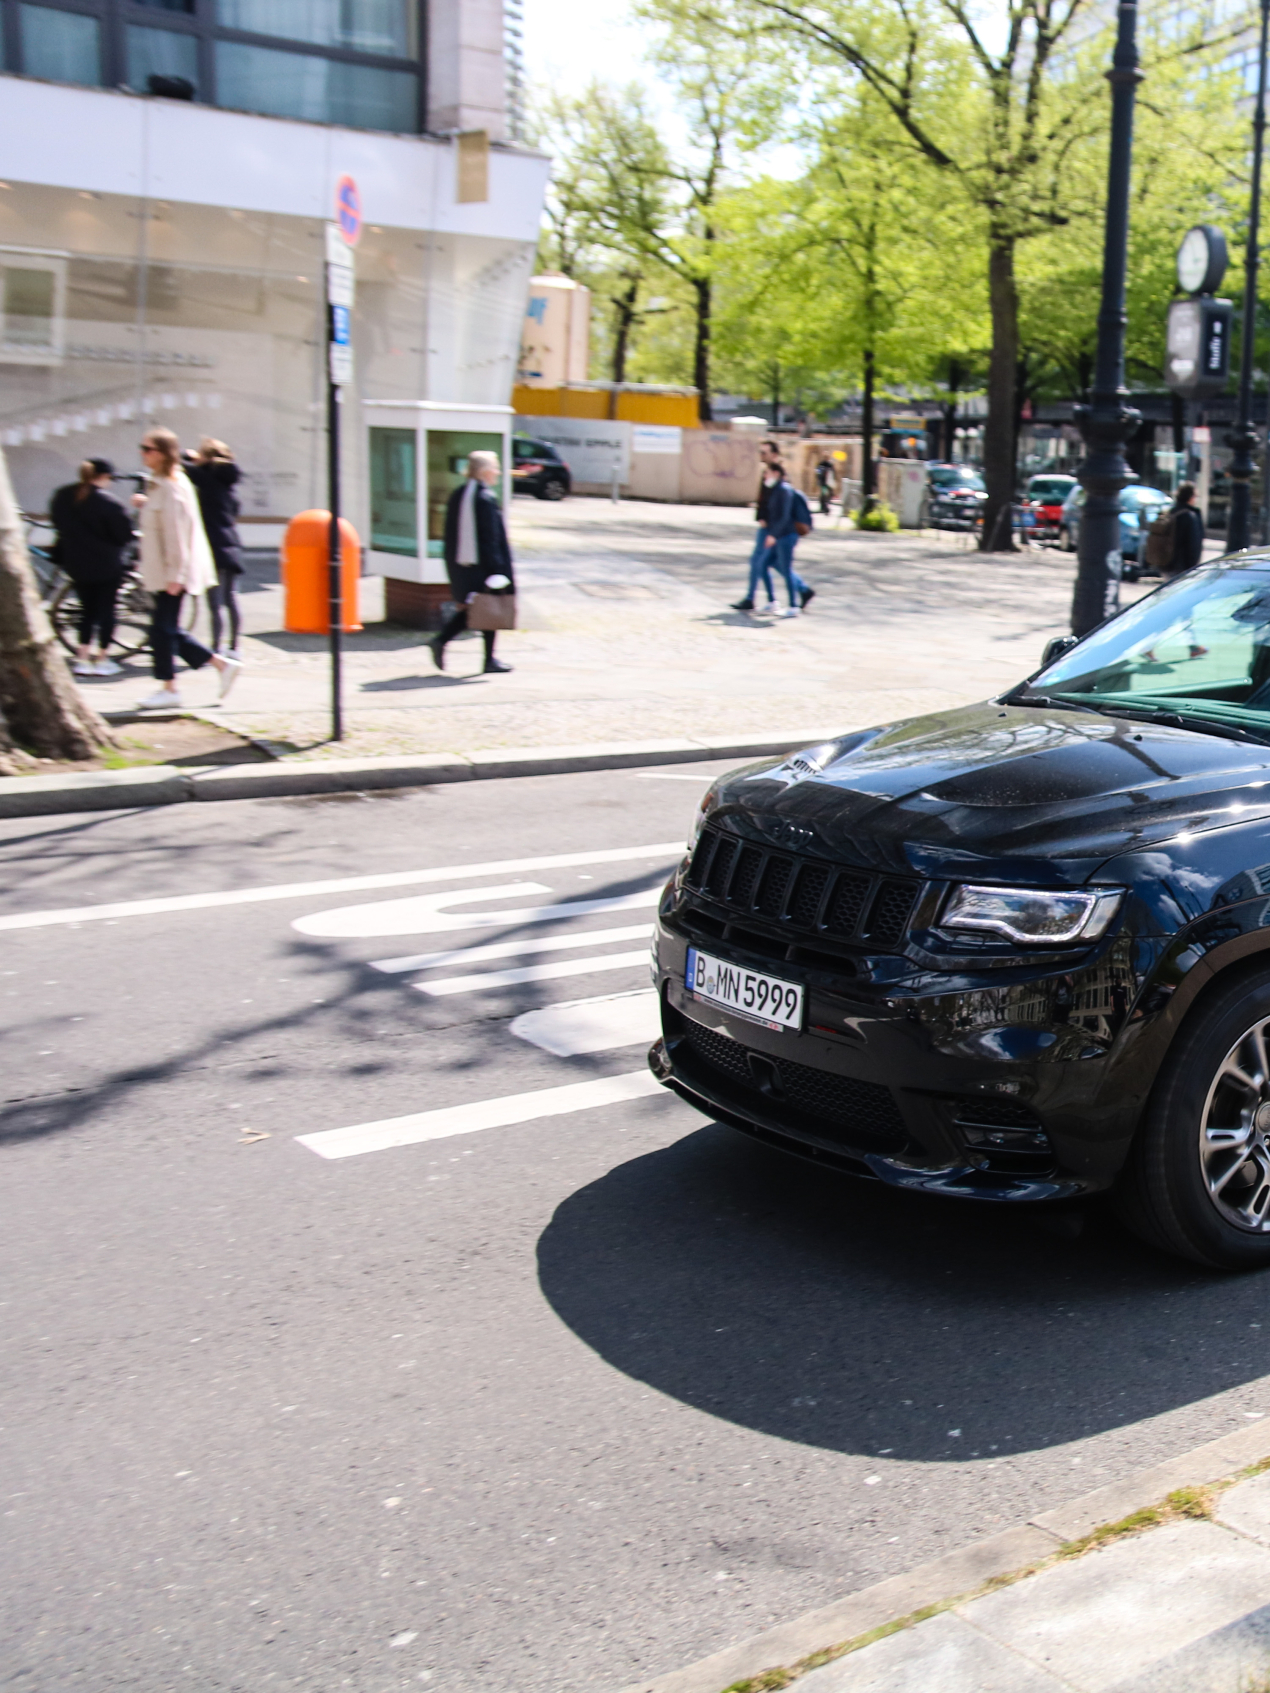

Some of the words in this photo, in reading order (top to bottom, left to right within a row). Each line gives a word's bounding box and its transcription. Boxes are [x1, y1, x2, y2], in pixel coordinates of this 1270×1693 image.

[696, 956, 706, 988] B
[716, 964, 740, 1003] MN
[743, 974, 798, 1020] 5999
